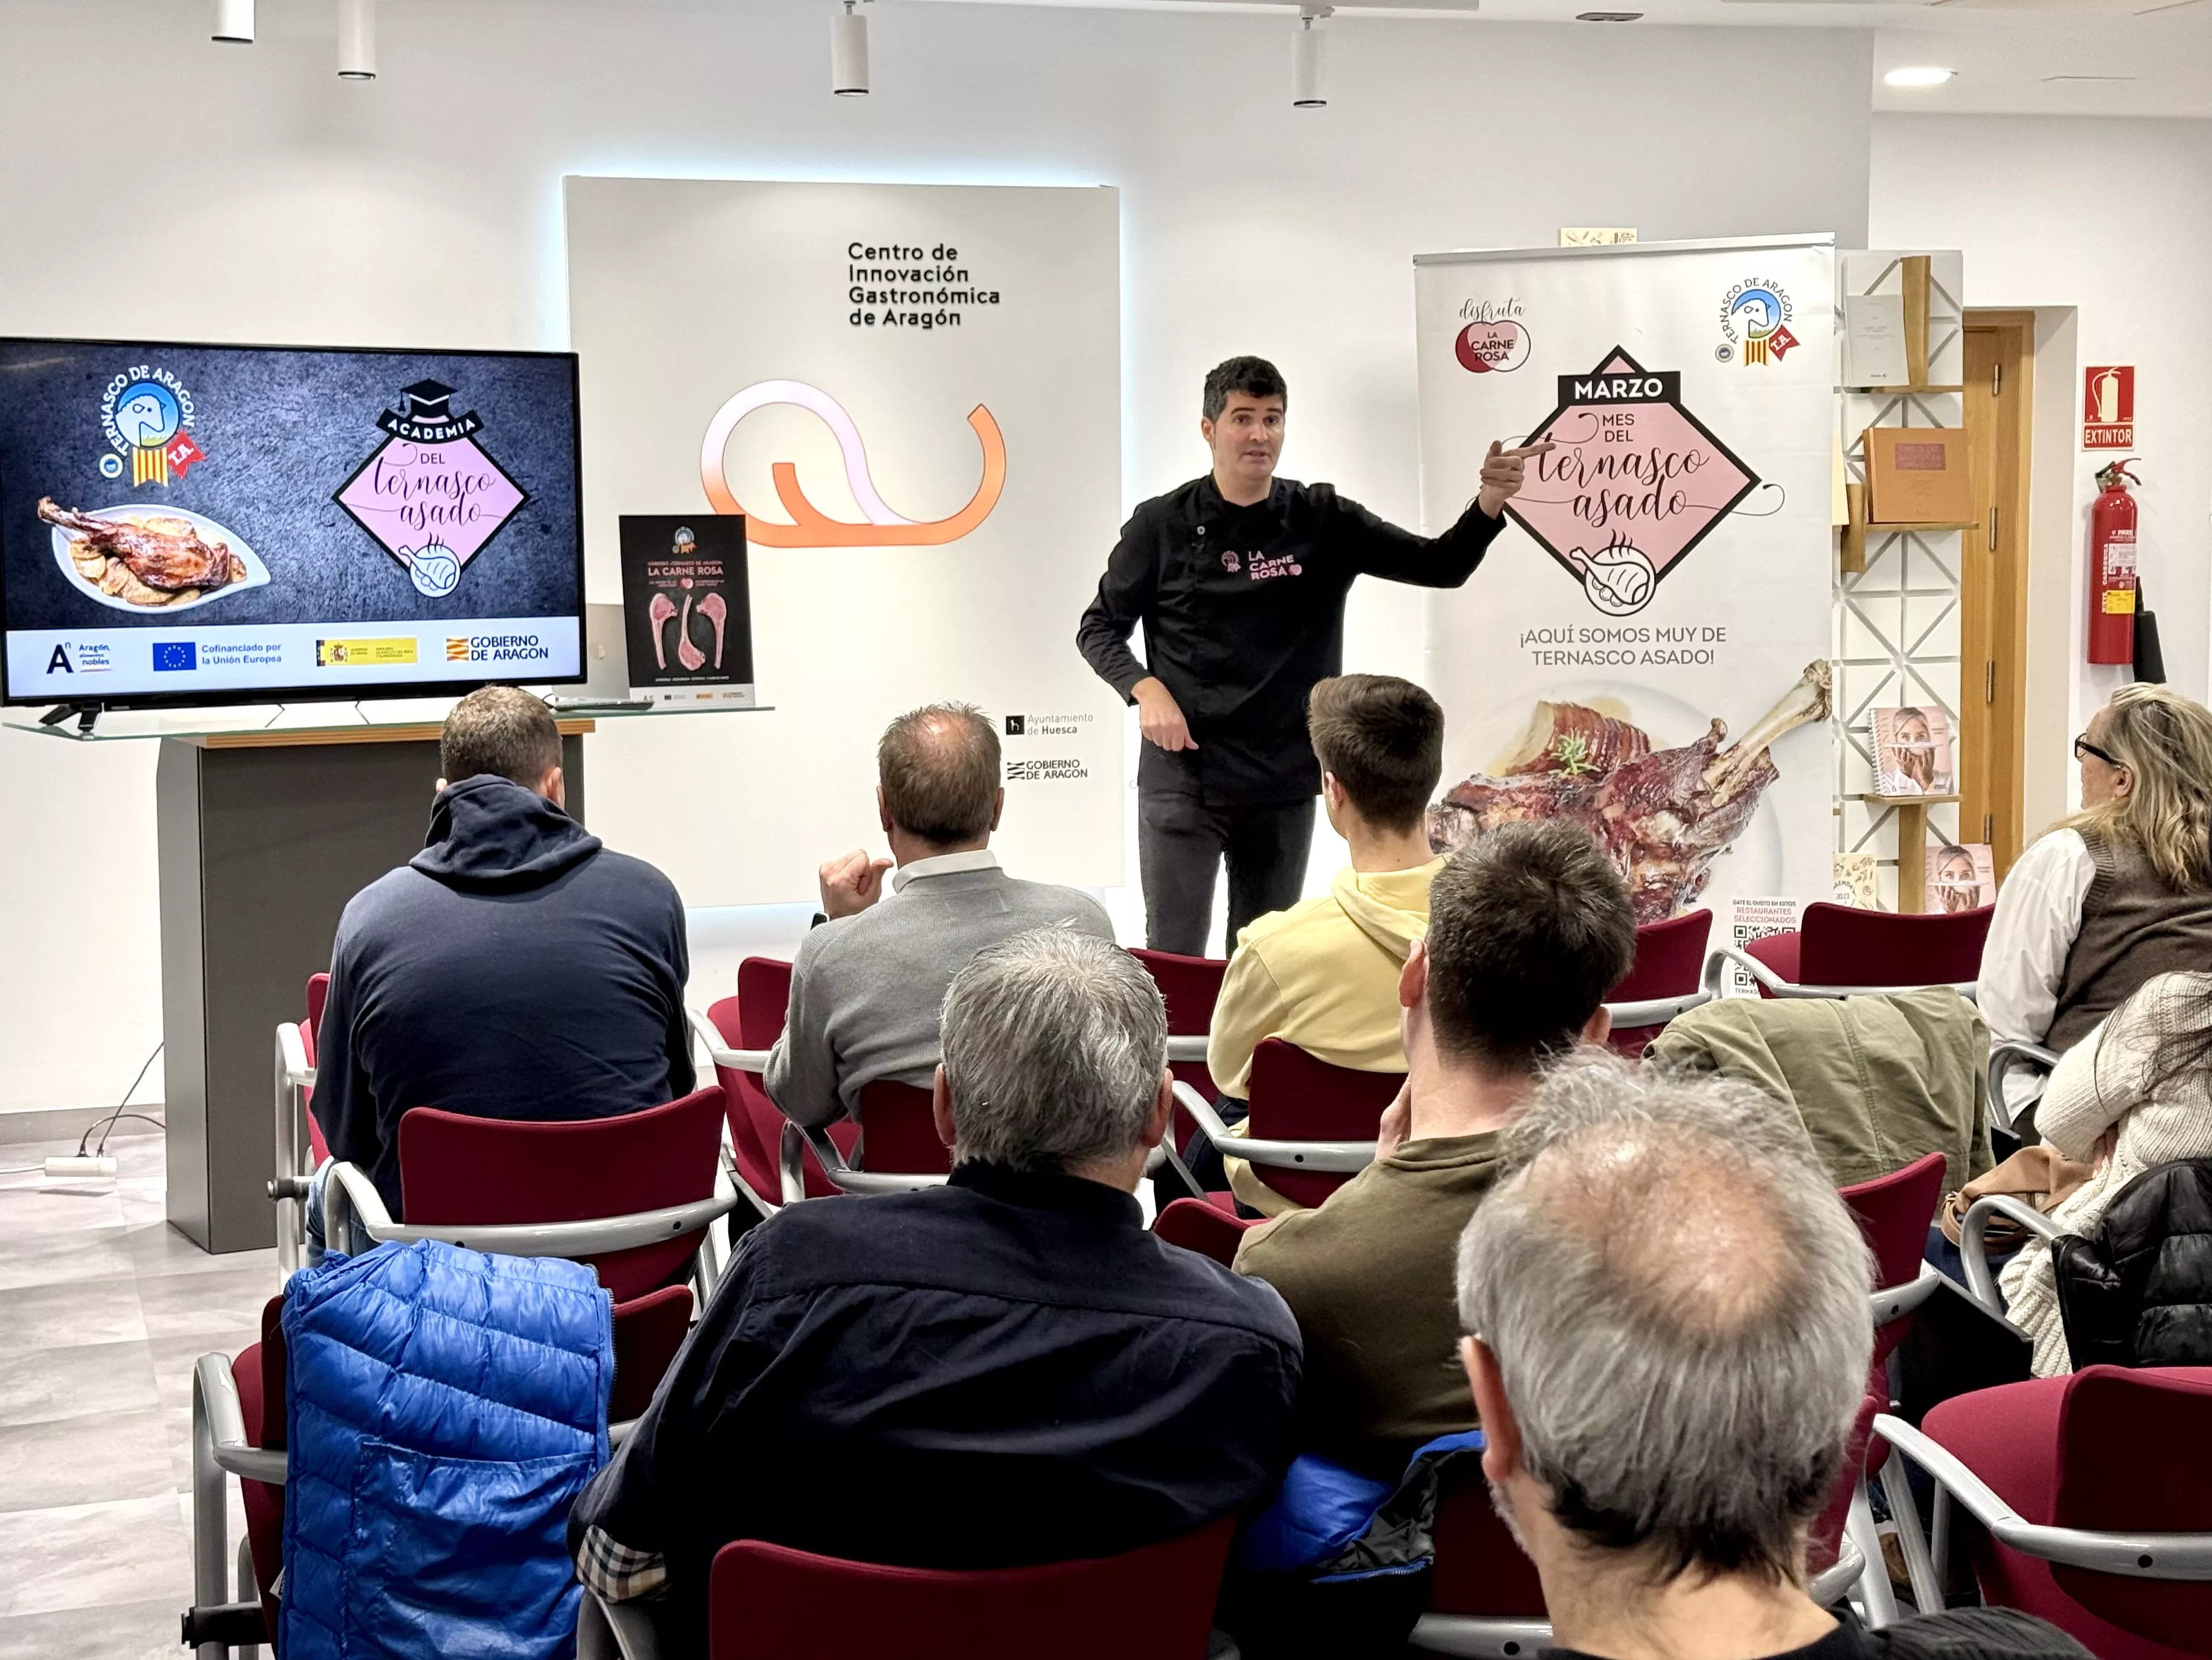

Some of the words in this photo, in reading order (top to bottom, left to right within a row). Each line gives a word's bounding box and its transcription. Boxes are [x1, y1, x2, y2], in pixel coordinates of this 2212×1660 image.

[848, 242, 924, 261] Centro
[932, 243, 958, 261] de
[849, 264, 969, 283] Innovación
[849, 286, 1000, 304] Gastronómica
[1459, 297, 1526, 326] disfruta
[1719, 284, 1742, 345] TERNASCO
[1744, 278, 1760, 288] DE
[1762, 279, 1792, 322] ARAGON
[849, 308, 876, 326] de
[882, 308, 961, 330] Aragón
[1471, 339, 1515, 351] CARNE
[1475, 351, 1510, 362] ROSA
[1574, 378, 1663, 400] MARZO
[101, 374, 129, 456] TERNASCO
[129, 365, 150, 381] DE
[152, 368, 195, 428] ARAGON
[1602, 413, 1635, 427] MES
[387, 418, 476, 440] ACADEMIA
[1604, 430, 1634, 443] DEL
[2085, 429, 2132, 444] EXTINTOR
[420, 453, 446, 465] DEL
[1538, 432, 1710, 488] ternasco
[374, 456, 497, 501] ternasco
[1573, 473, 1687, 528] asado
[400, 490, 482, 531] asado
[1248, 550, 1265, 561] LA
[1249, 554, 1294, 572] CARNE
[648, 567, 660, 576] LA
[662, 566, 695, 576] CARNE
[698, 566, 724, 575] ROSA
[1251, 566, 1288, 580] ROSA
[471, 635, 539, 648] GOBIERNO
[1520, 624, 1574, 649] ¡AQUÍ
[1579, 627, 1650, 643] SOMOS
[1656, 627, 1697, 643] MUY
[1702, 627, 1727, 642] DE
[202, 643, 263, 653] Cofinanciado
[266, 643, 282, 654] por
[471, 650, 488, 661] DE
[493, 647, 549, 660] ARAGON
[202, 656, 210, 665] la
[213, 656, 240, 665] Unión
[243, 655, 282, 665] Europea
[1532, 650, 1636, 666] TERNASCO
[1640, 650, 1715, 665] ASADO!
[1028, 713, 1093, 725] Ayuntamiento
[1028, 726, 1038, 735] de
[1042, 725, 1078, 735] Huesca
[1026, 759, 1080, 770] GOBIERNO
[1026, 771, 1040, 780] DE
[1044, 768, 1088, 779] ARAGON
[1737, 907, 1792, 915] RESTAURANTES
